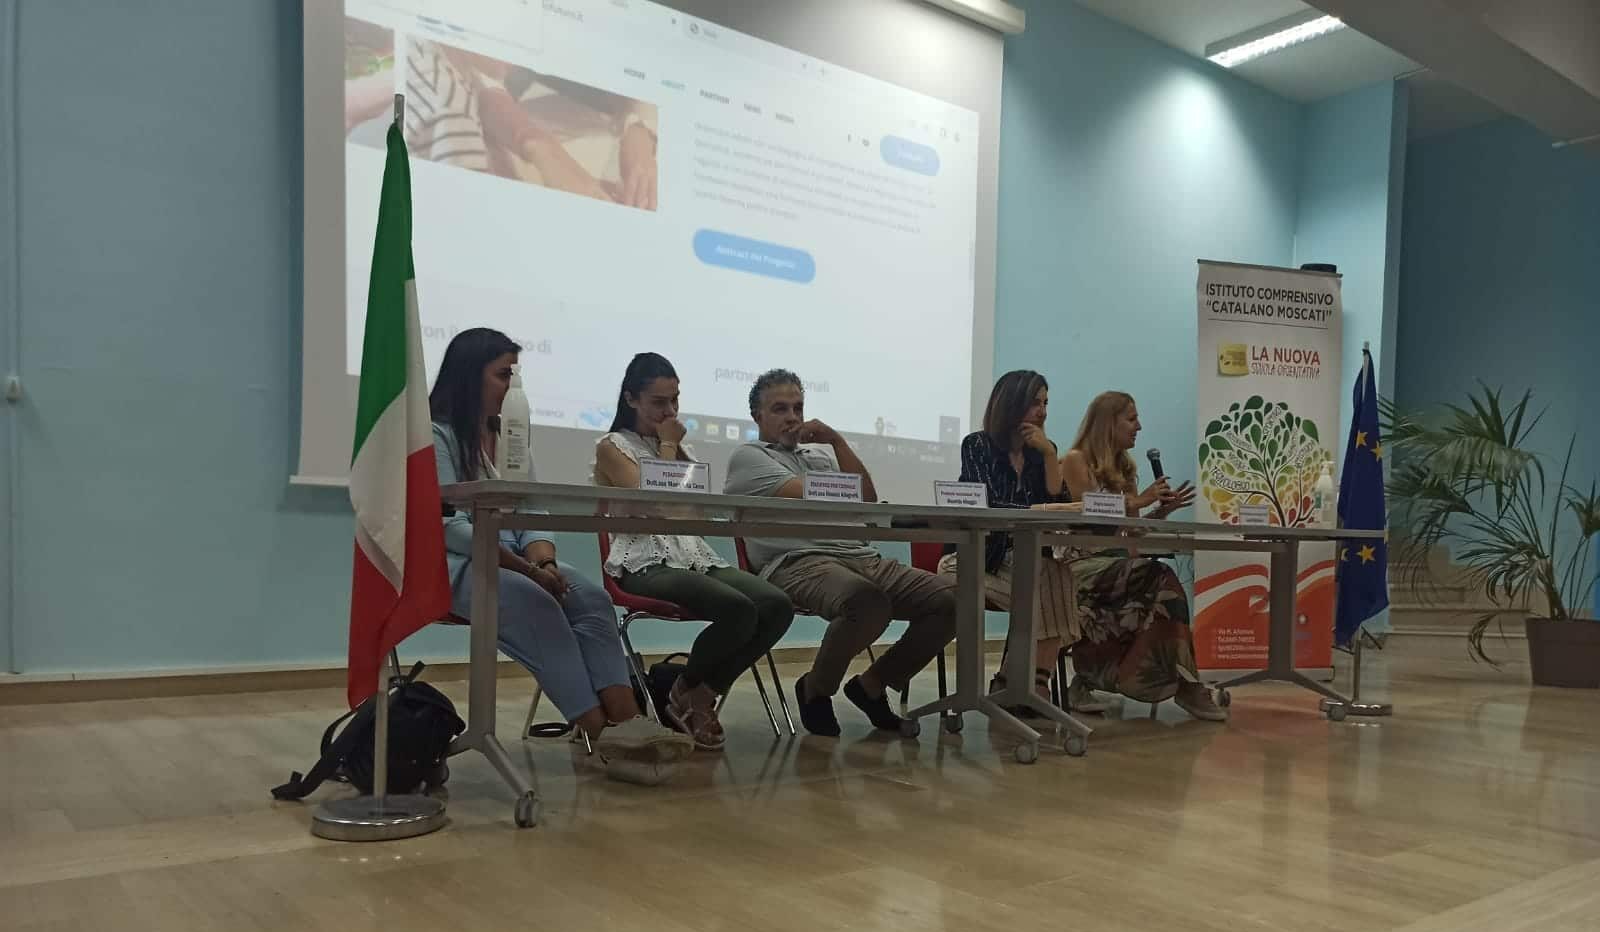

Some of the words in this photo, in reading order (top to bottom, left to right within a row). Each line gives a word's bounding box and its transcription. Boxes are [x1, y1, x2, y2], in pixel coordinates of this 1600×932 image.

[1206, 283, 1255, 299] ISTITUTO
[1256, 287, 1334, 306] COMPRENSIVO
[1251, 346, 1268, 360] LA
[1273, 347, 1321, 366] NUOVA
